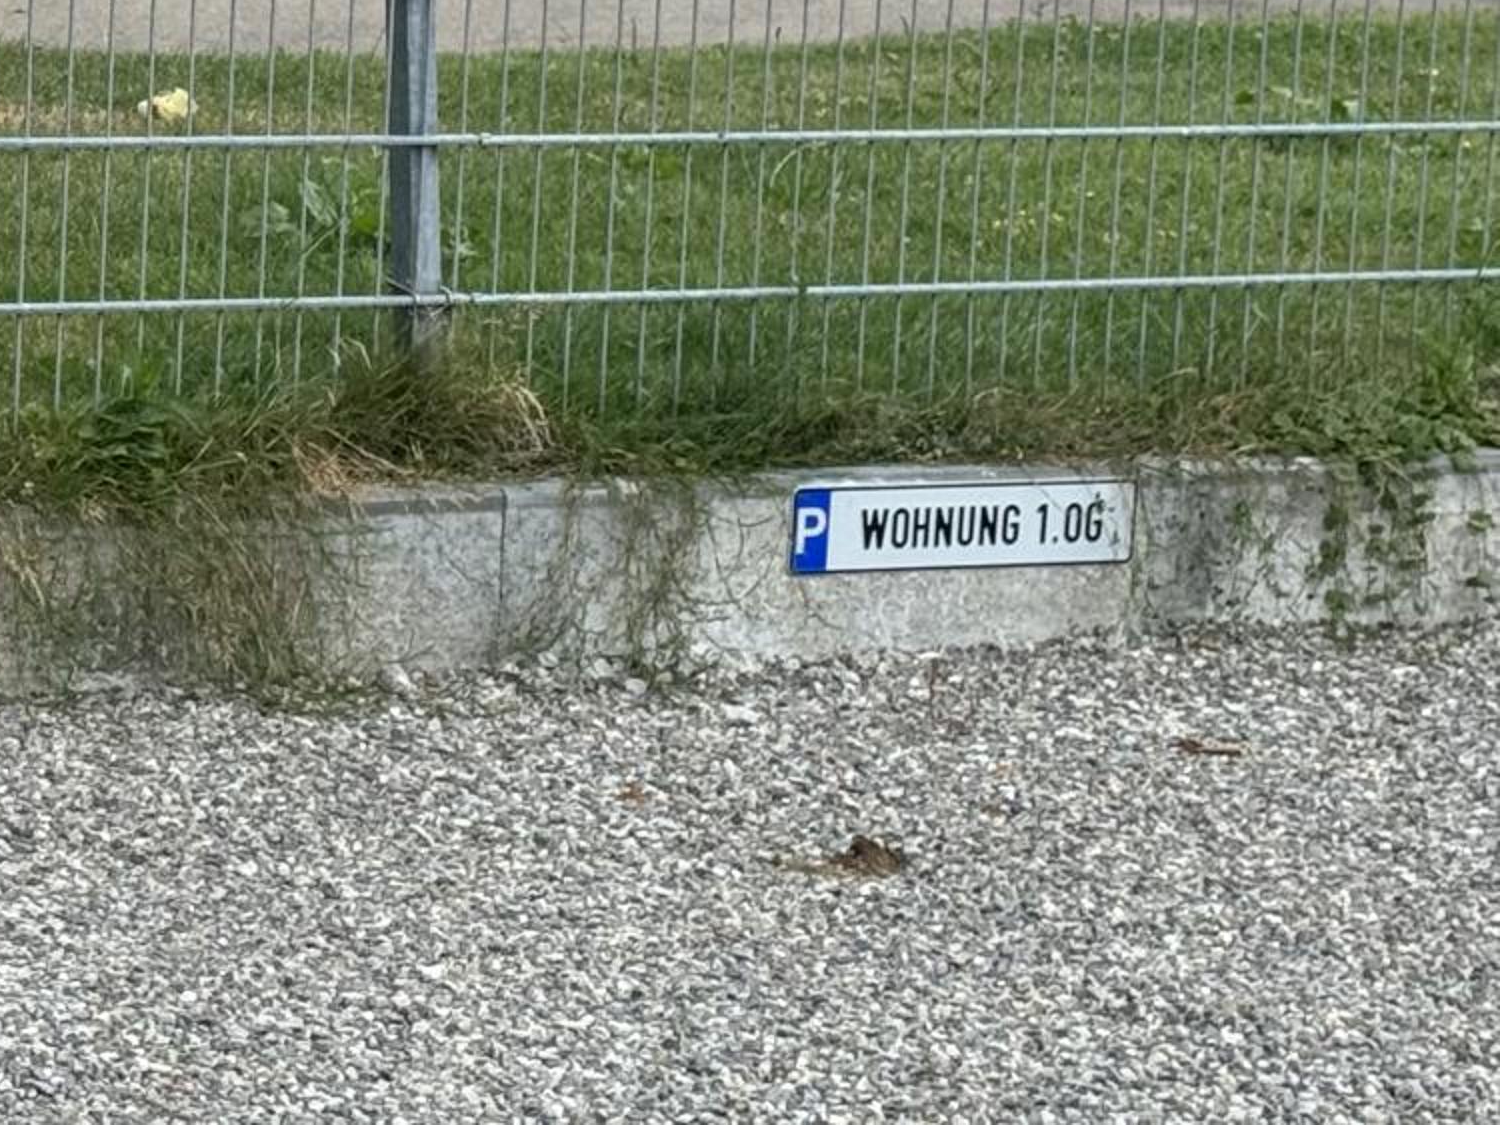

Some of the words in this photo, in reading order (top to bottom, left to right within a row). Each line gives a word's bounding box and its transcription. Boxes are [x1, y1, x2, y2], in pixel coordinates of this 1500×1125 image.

[795, 507, 827, 555] P
[861, 504, 1021, 550] WOHNUNG
[1036, 502, 1103, 545] 1.OG
